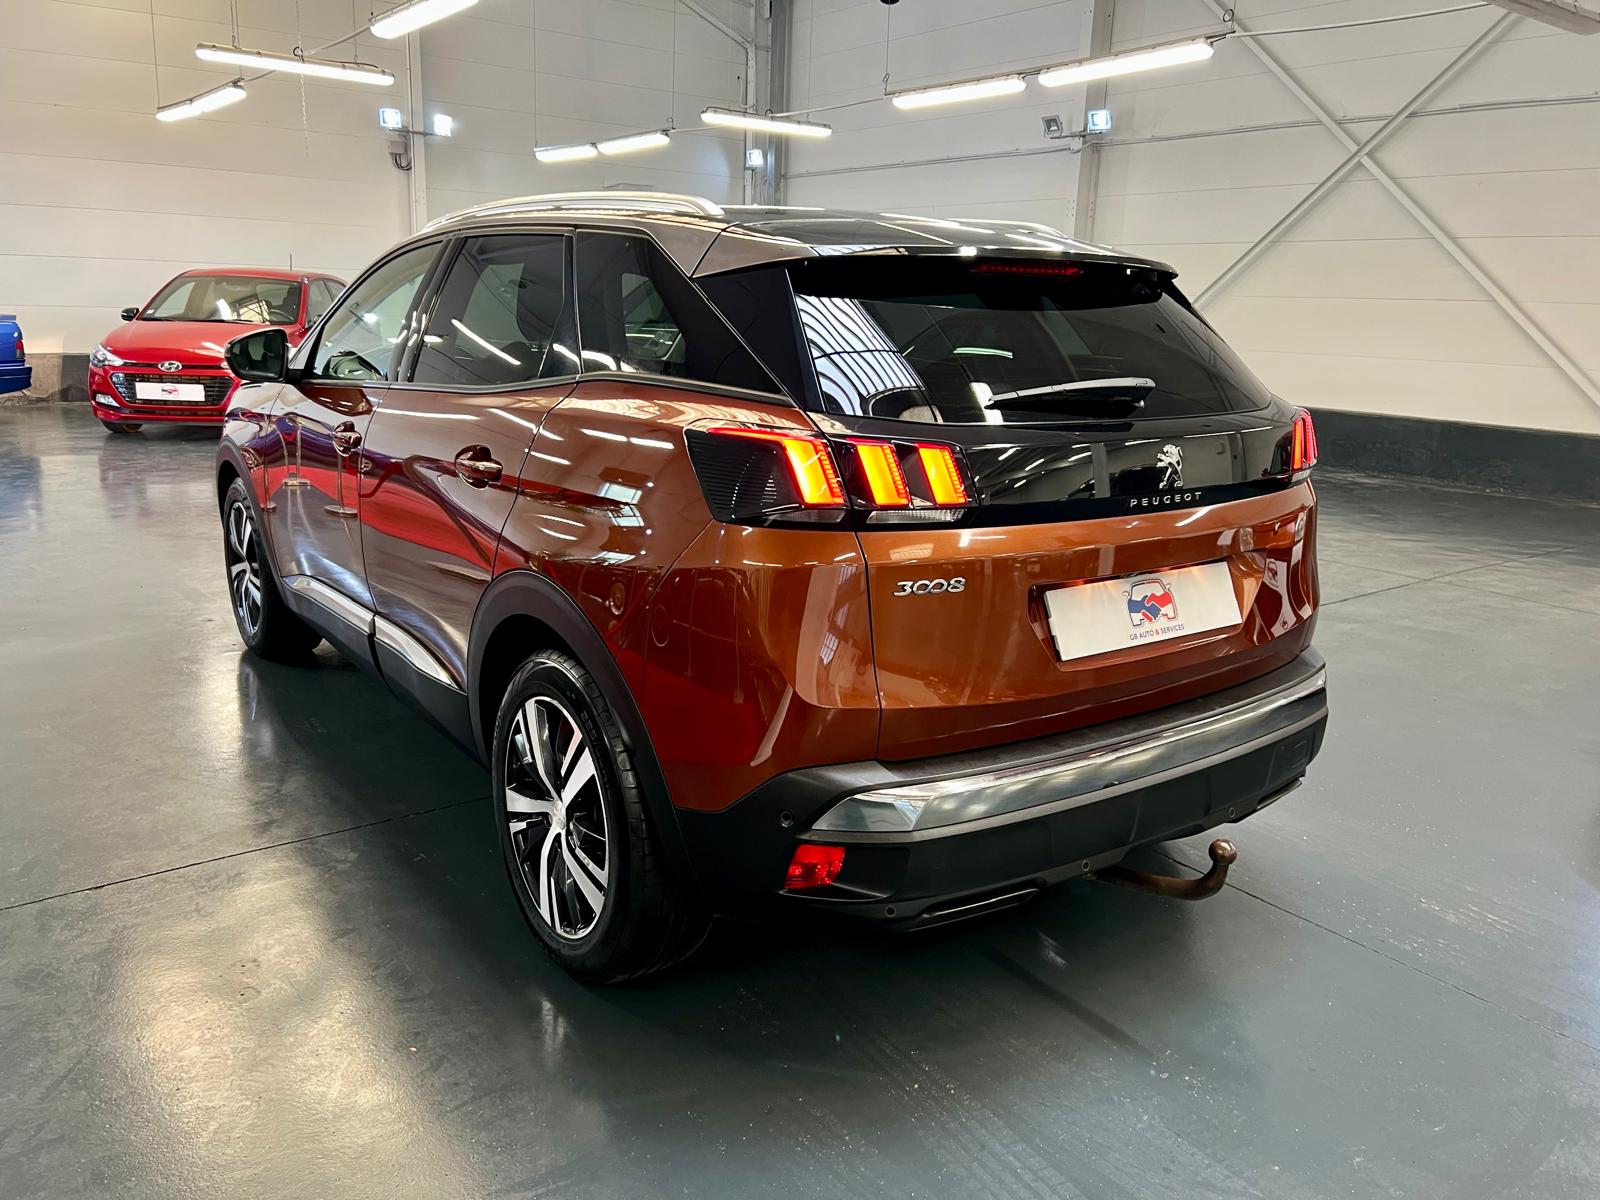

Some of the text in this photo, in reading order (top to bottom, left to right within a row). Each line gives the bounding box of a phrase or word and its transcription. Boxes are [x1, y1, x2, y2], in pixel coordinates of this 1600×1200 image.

[1130, 491, 1202, 508] PEUGEOT
[893, 577, 966, 597] 3008
[1130, 633, 1138, 641] GB
[1139, 630, 1154, 638] AUTO
[1160, 624, 1184, 634] SERVICES
